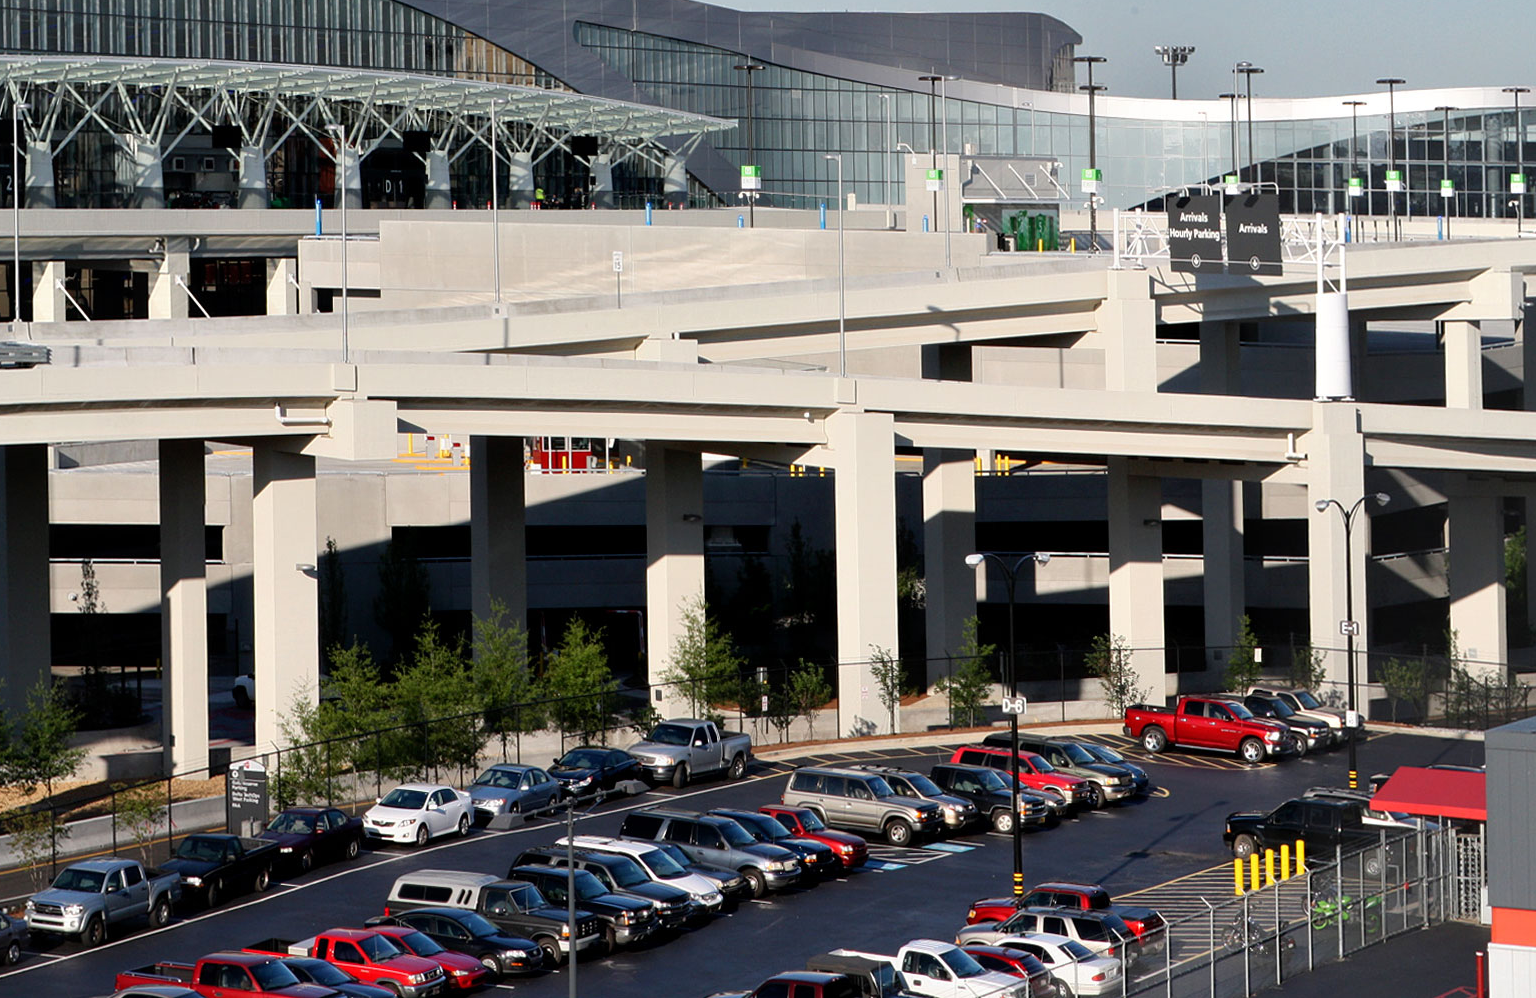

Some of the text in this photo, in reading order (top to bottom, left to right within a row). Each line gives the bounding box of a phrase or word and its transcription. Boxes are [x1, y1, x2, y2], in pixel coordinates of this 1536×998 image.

[1179, 211, 1209, 222] Arrivals
[1169, 228, 1220, 241] Hourly Parking
[1238, 223, 1268, 234] Arrivals
[1341, 621, 1358, 635] E-1
[1002, 698, 1024, 713] D-6
